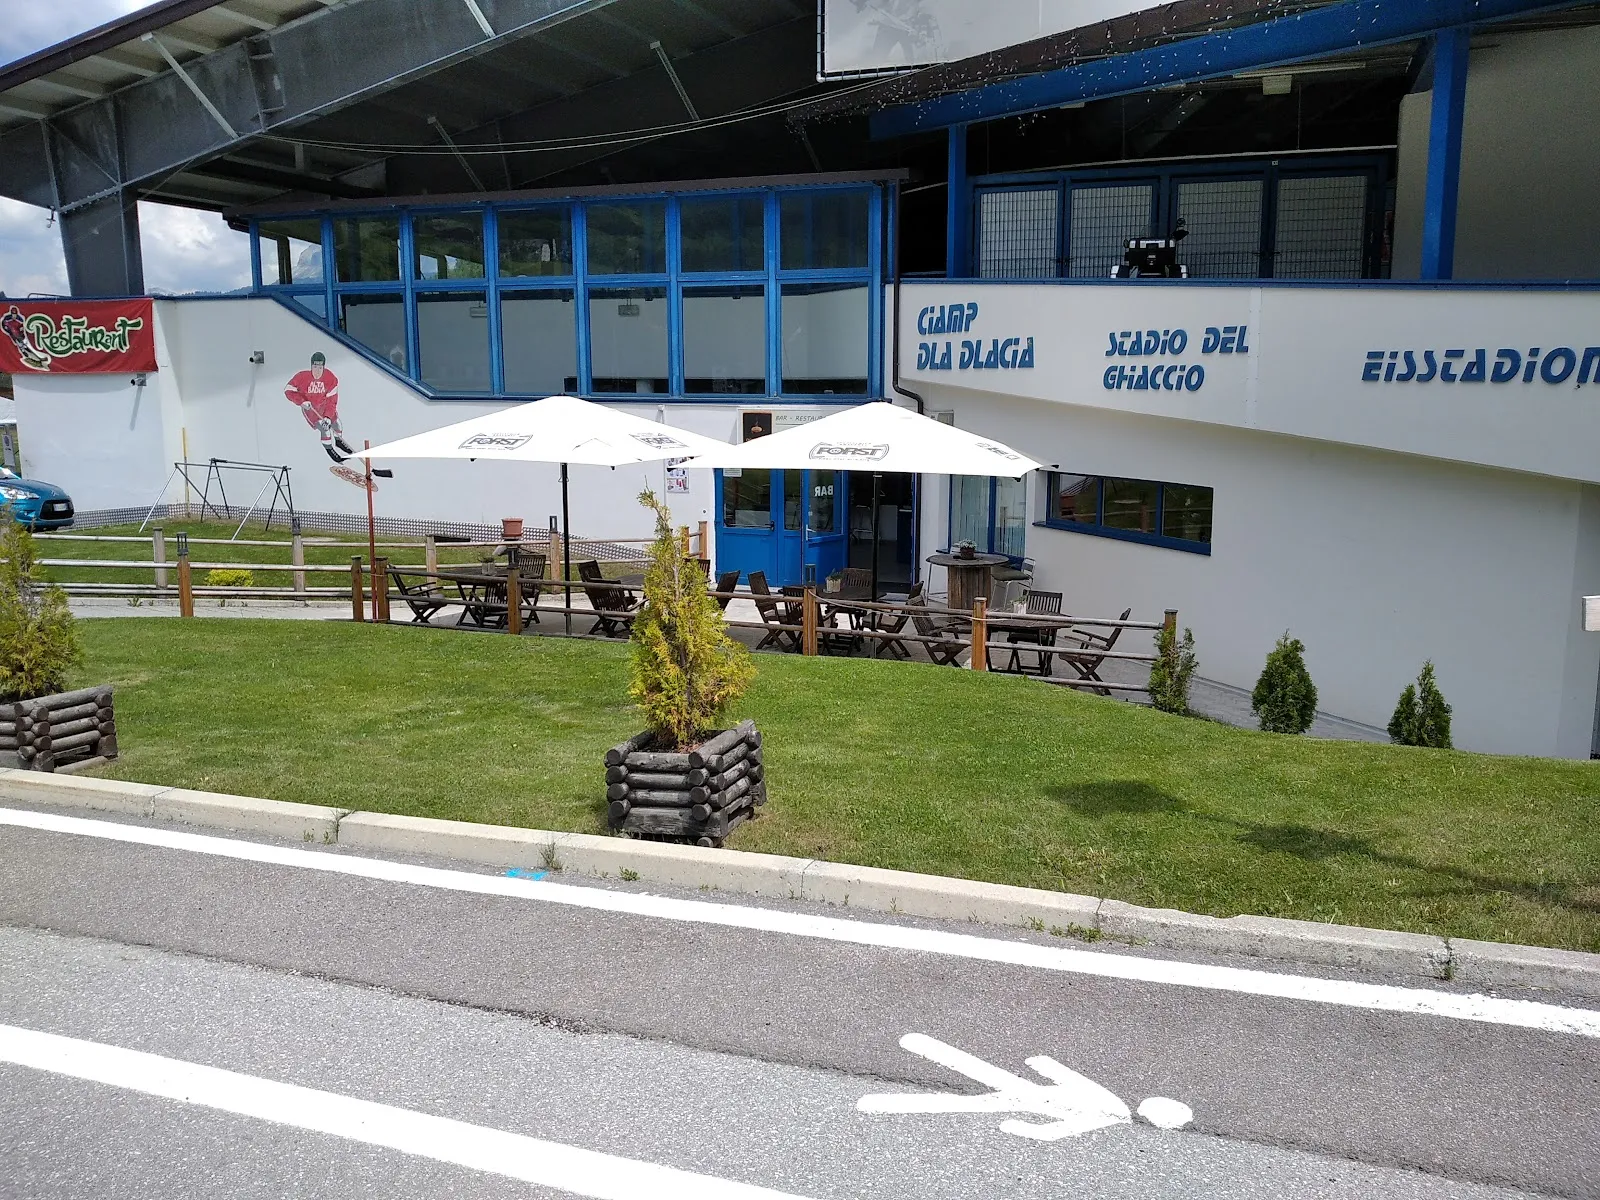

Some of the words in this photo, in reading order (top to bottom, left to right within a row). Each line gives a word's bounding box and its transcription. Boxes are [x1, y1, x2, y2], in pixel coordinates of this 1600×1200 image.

[1201, 325, 1249, 353] DEL
[917, 341, 952, 370] DLA
[468, 437, 525, 445] FORST
[816, 447, 883, 456] FORST
